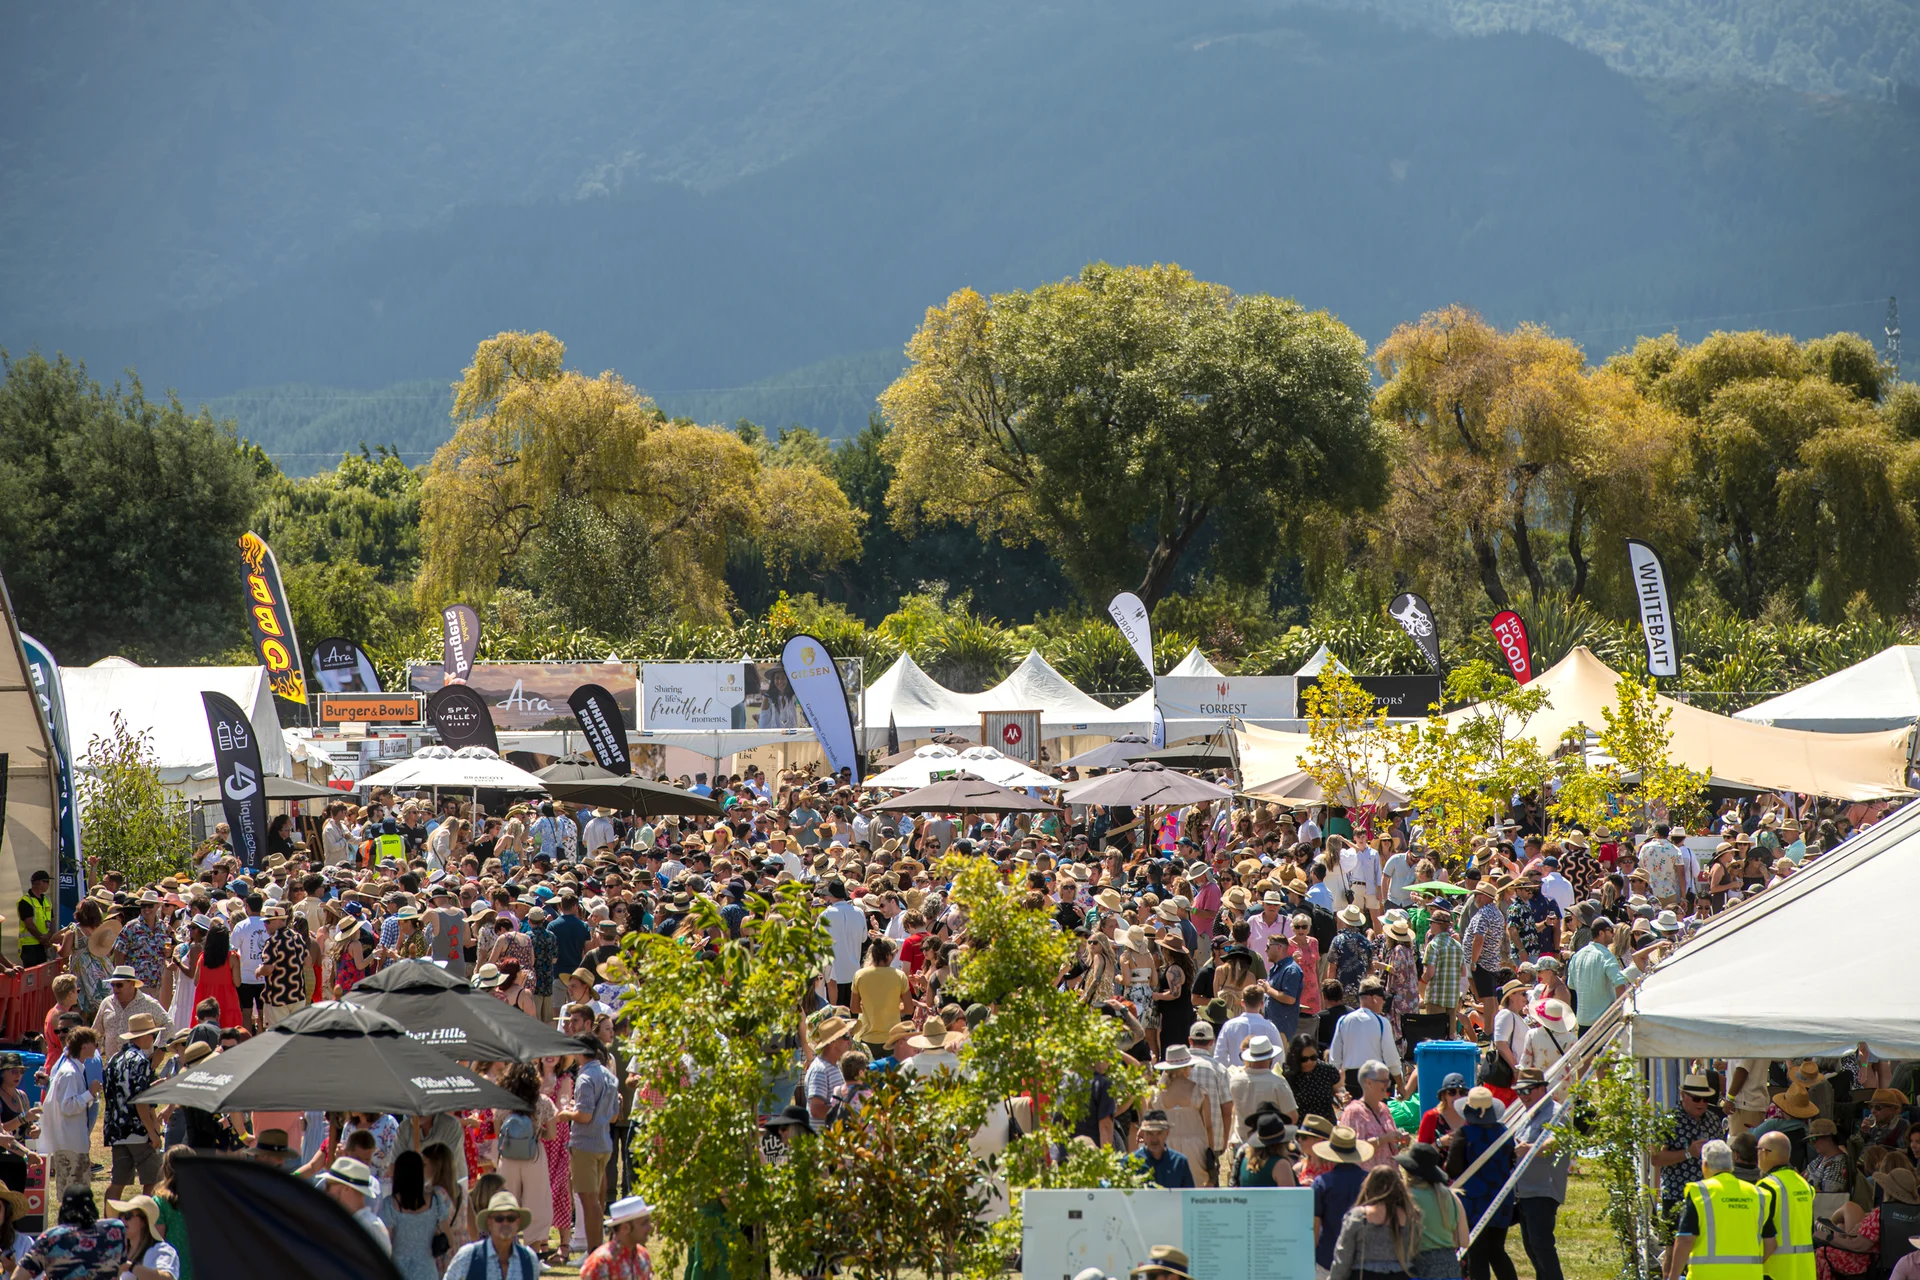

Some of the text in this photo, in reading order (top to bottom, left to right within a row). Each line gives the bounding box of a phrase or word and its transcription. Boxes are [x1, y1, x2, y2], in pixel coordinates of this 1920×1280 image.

[1639, 561, 1669, 667] WHITEBAIT
[1507, 616, 1523, 640] HOT
[323, 646, 354, 663] Ara
[1494, 622, 1527, 673] FOOD
[790, 666, 831, 680] GIESEN
[495, 678, 555, 712] Ara
[654, 685, 683, 694] Sharing
[325, 704, 371, 721] Burger
[379, 704, 415, 716] Bowls
[439, 713, 478, 721] VALLEY
[447, 706, 469, 714] SPY
[650, 696, 713, 721] fruitful
[1199, 703, 1248, 715] FORREST
[577, 708, 613, 768] FRITTERS
[586, 696, 626, 764] WHITEBAIT
[431, 1027, 467, 1039] Hills
[1190, 1197, 1218, 1205] Festival
[1233, 1197, 1248, 1205] Map
